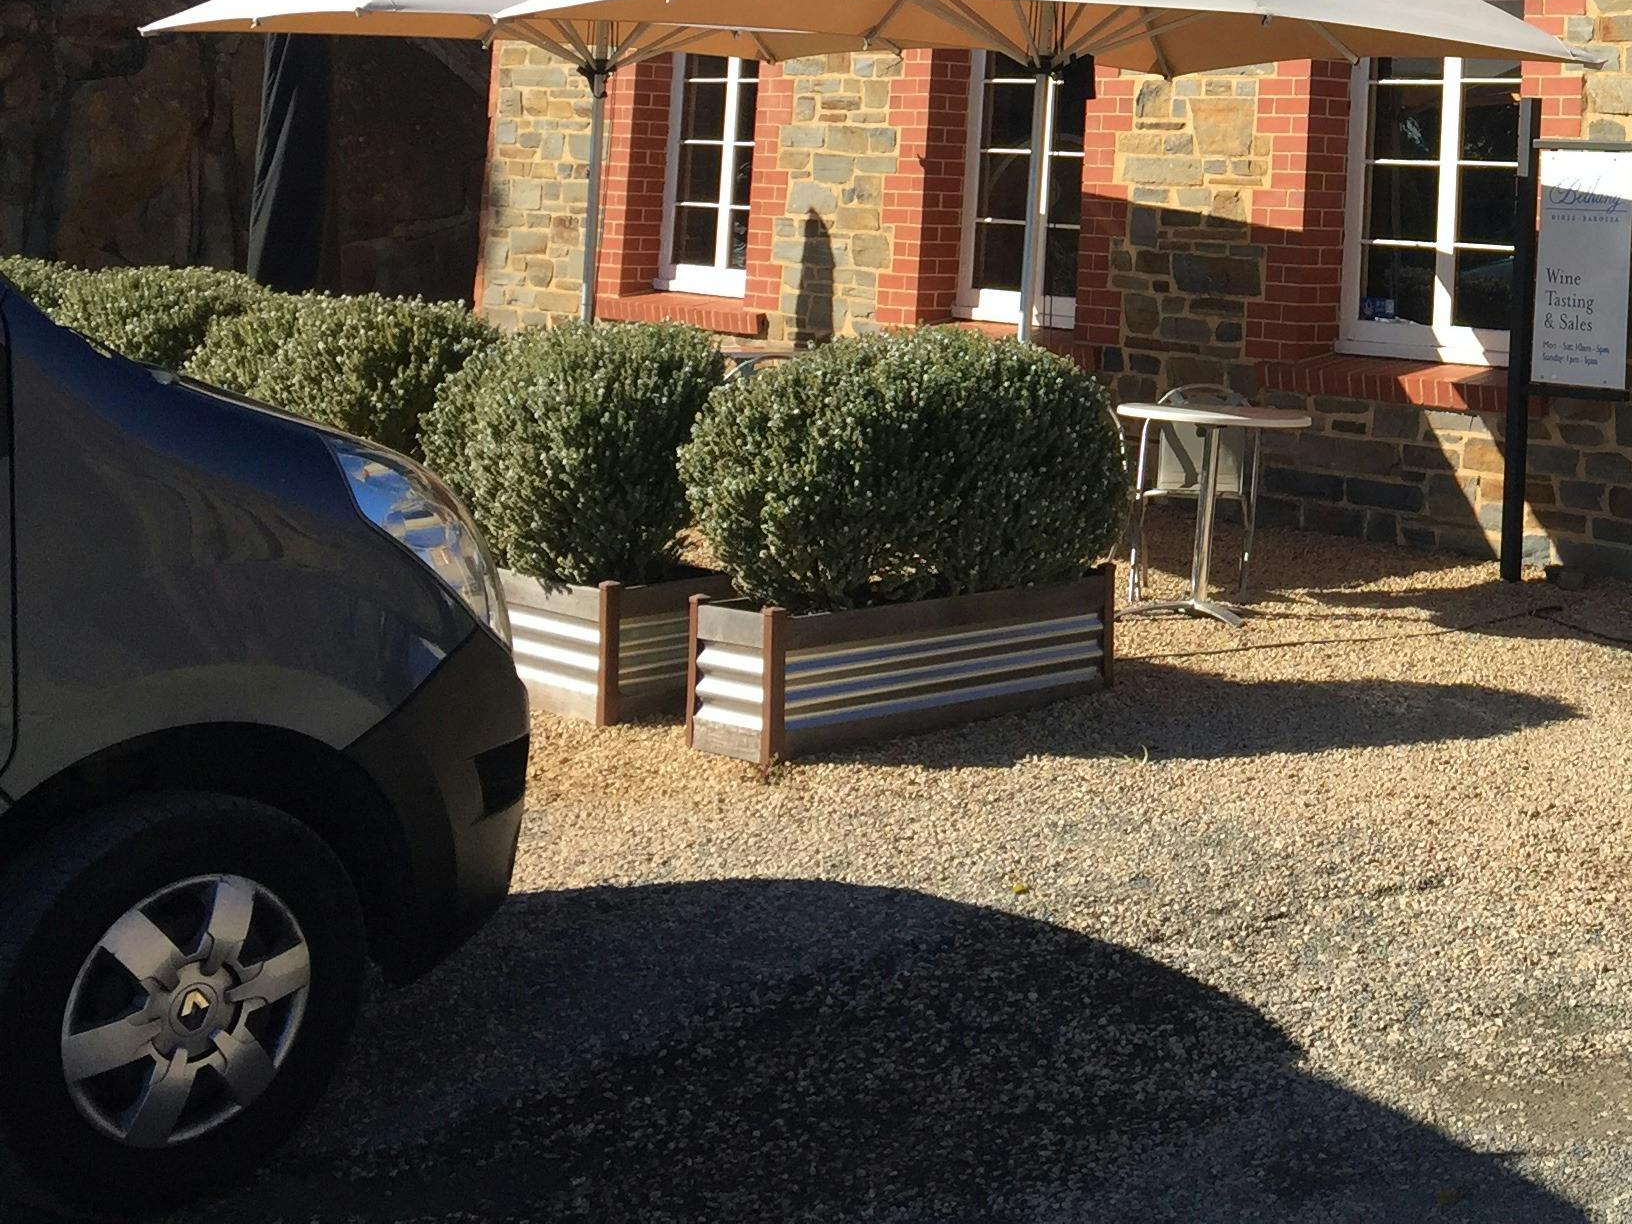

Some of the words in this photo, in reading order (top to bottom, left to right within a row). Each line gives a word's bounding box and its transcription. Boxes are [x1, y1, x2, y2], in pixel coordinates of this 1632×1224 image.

[1549, 177, 1621, 214] Bethany
[1546, 267, 1581, 286] Wine
[1545, 290, 1594, 315] Tasting
[1544, 312, 1554, 329] &
[1559, 313, 1593, 332] Sales
